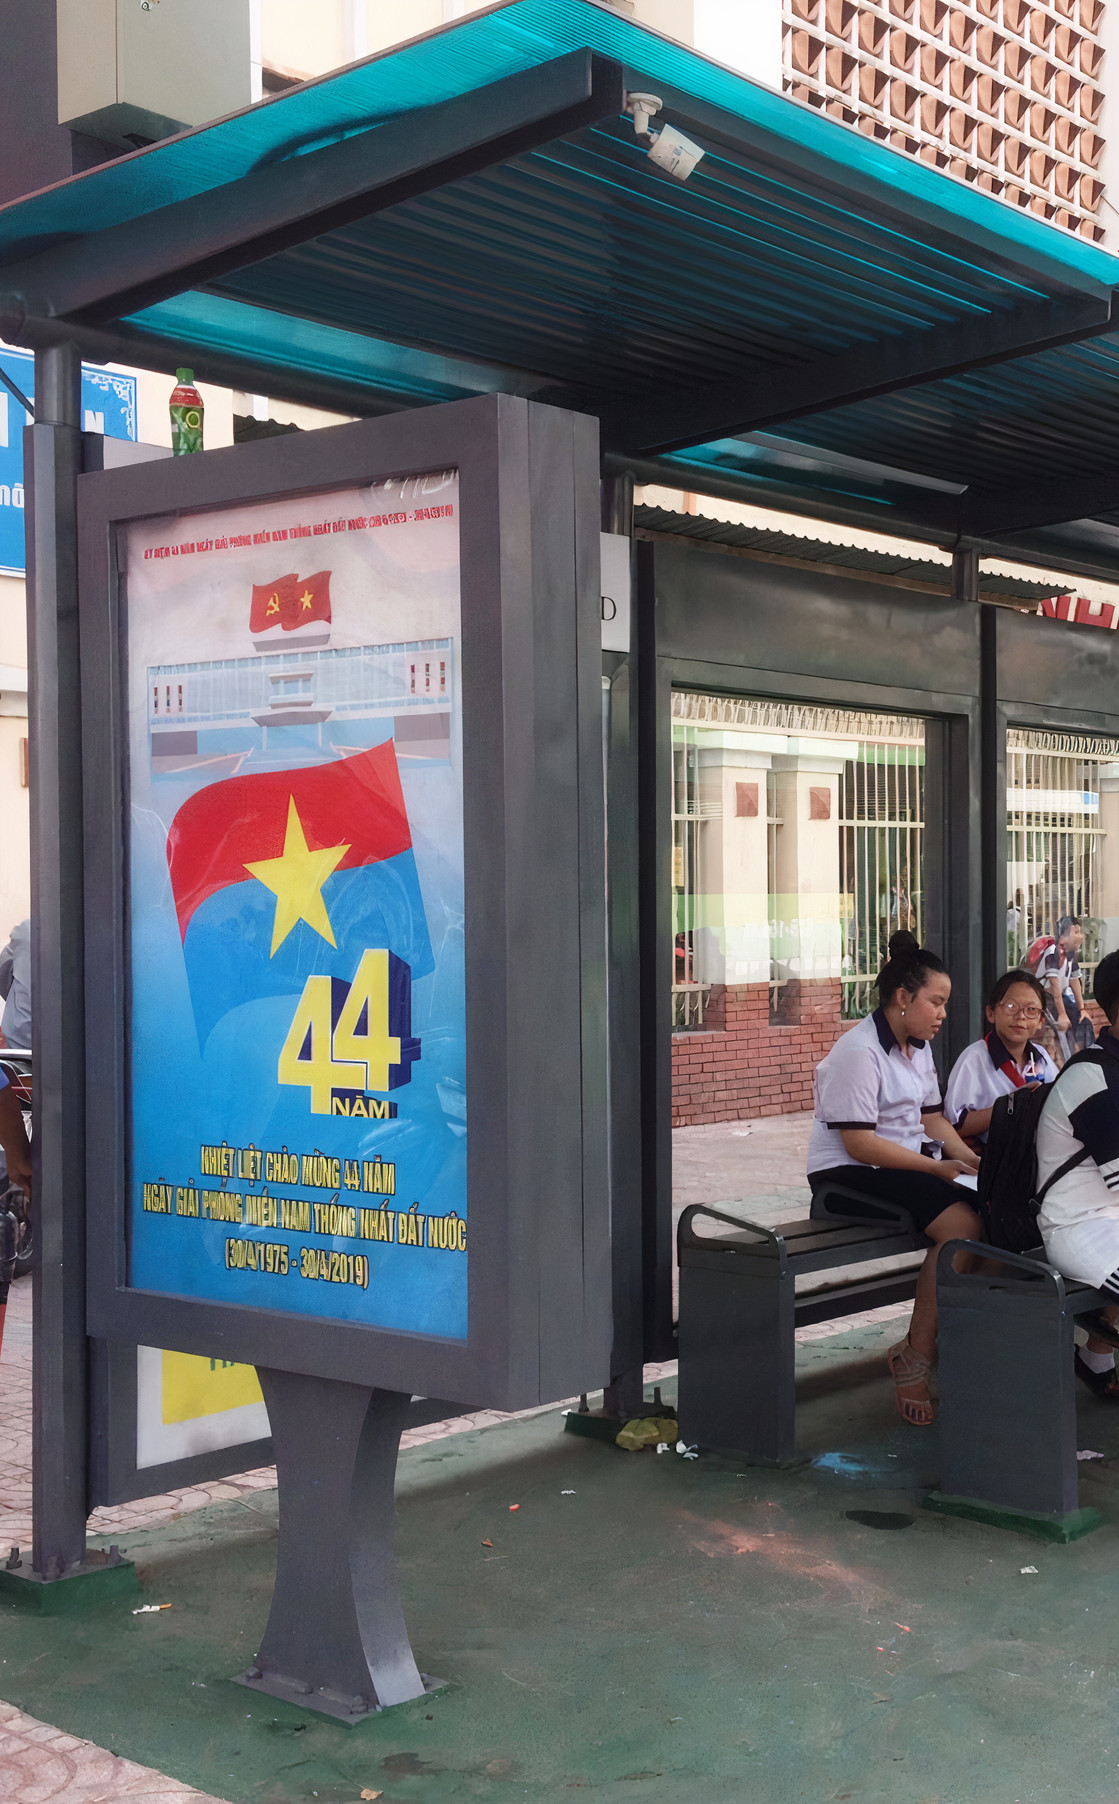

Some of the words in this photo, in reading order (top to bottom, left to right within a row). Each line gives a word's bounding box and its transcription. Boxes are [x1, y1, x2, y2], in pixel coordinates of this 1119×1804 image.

[278, 948, 402, 1114] 44
[265, 1146, 299, 1185] CHÀO
[343, 1159, 361, 1191] 44
[280, 1199, 311, 1232] NAM
